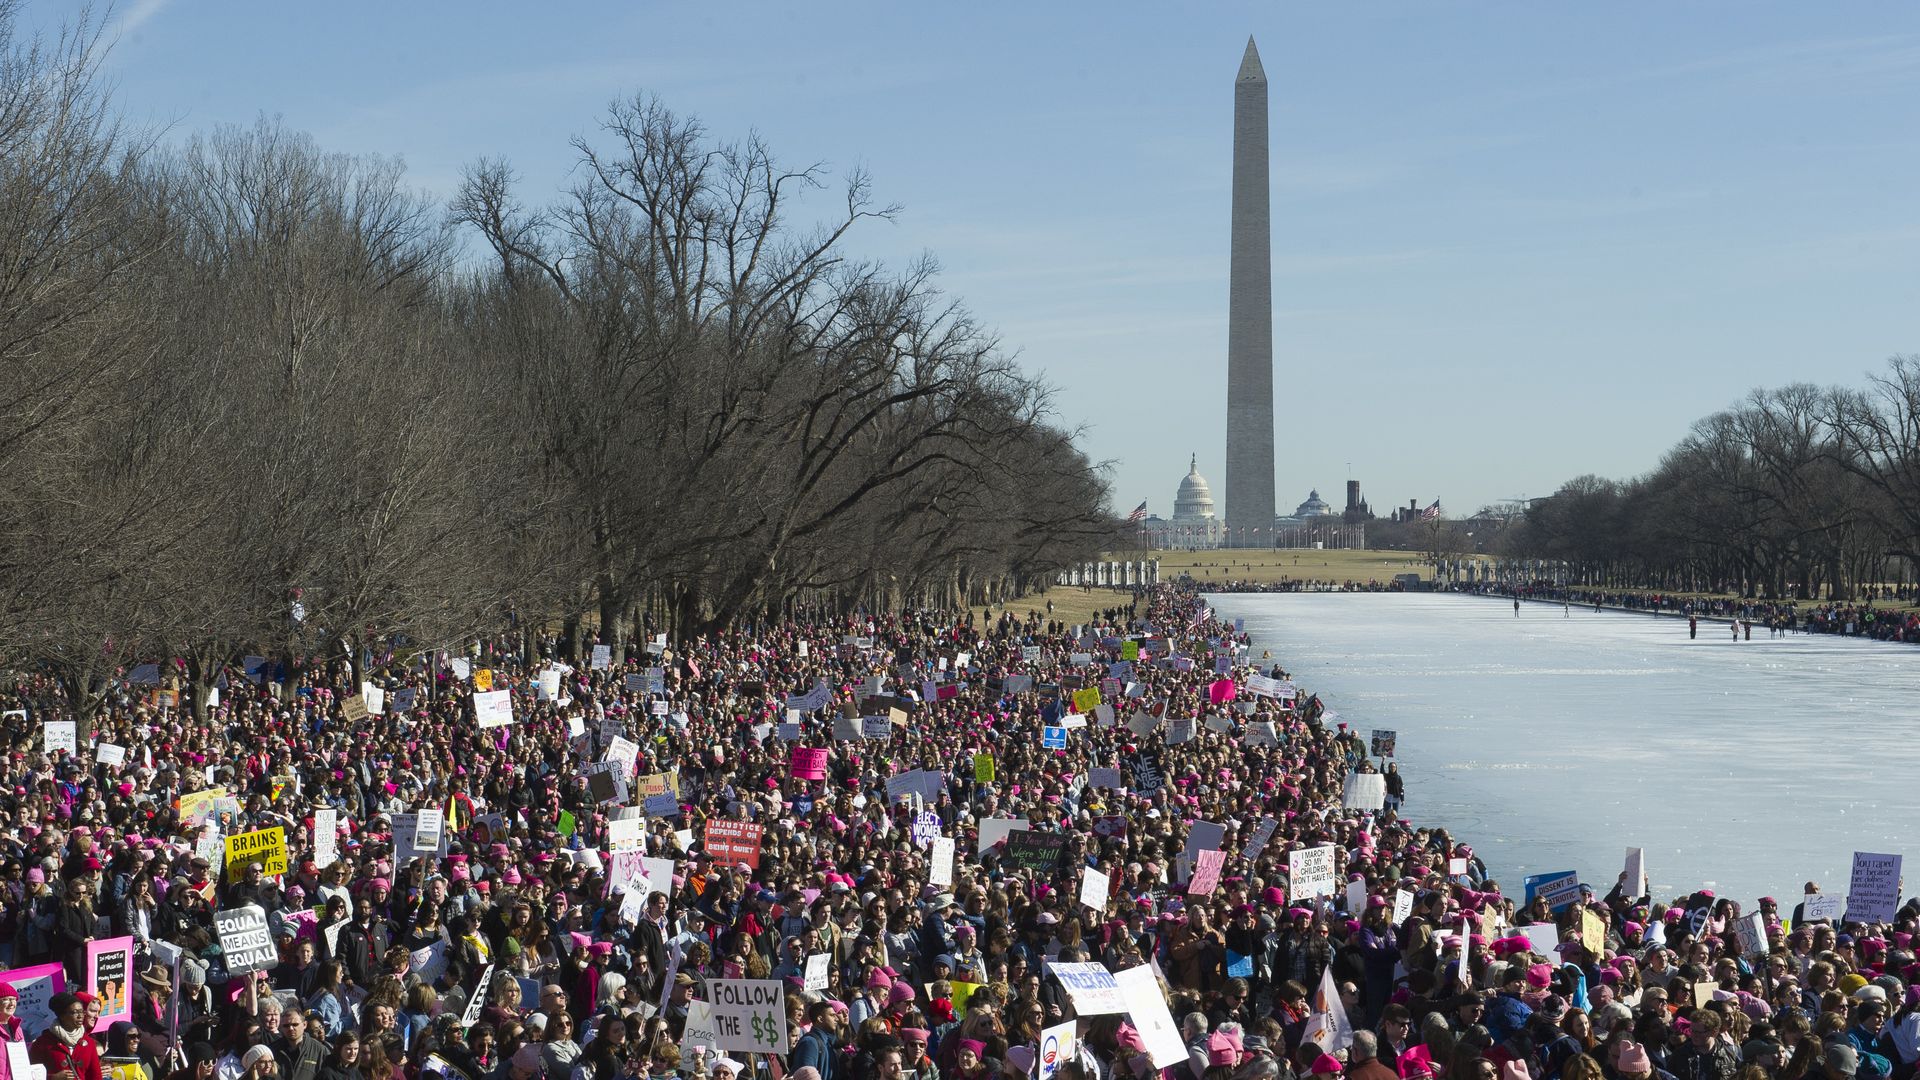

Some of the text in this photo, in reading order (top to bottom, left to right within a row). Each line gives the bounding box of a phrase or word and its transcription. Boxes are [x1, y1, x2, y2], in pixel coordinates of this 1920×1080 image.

[794, 750, 822, 759] WOMEN
[1130, 754, 1155, 773] WE
[639, 777, 650, 785] MY
[1134, 770, 1158, 783] ARE
[917, 811, 939, 825] ELECT
[709, 828, 742, 837] DEPENDS
[711, 820, 760, 832] INJUSTICE
[913, 823, 941, 836] WOMEN
[232, 831, 277, 852] BRAINS
[730, 838, 758, 846] PEOPLE
[1026, 834, 1040, 846] Year
[708, 843, 754, 854] BEING QUIET
[1039, 848, 1059, 860] Still
[1305, 849, 1325, 858] MARCH
[232, 851, 252, 865] ARE
[260, 847, 280, 859] THE
[1855, 852, 1895, 870] You raped
[1304, 859, 1312, 867] SO
[1300, 865, 1328, 876] CHILDREN
[1853, 867, 1892, 876] her because
[1292, 872, 1334, 885] WON'T HAVE TO
[1851, 875, 1884, 883] her clothes
[631, 878, 648, 896] DONALD
[1538, 880, 1565, 895] DISSENT
[1566, 877, 1574, 885] IS
[1851, 881, 1875, 890] provoked
[1548, 891, 1576, 905] ATRIOTIC
[216, 913, 265, 935] EQUAL
[223, 931, 267, 950] MEANS
[226, 948, 275, 969] EQUAL
[411, 943, 441, 967] ASTY
[713, 982, 779, 1007] FOLLOW
[715, 1010, 779, 1048] THE $$
